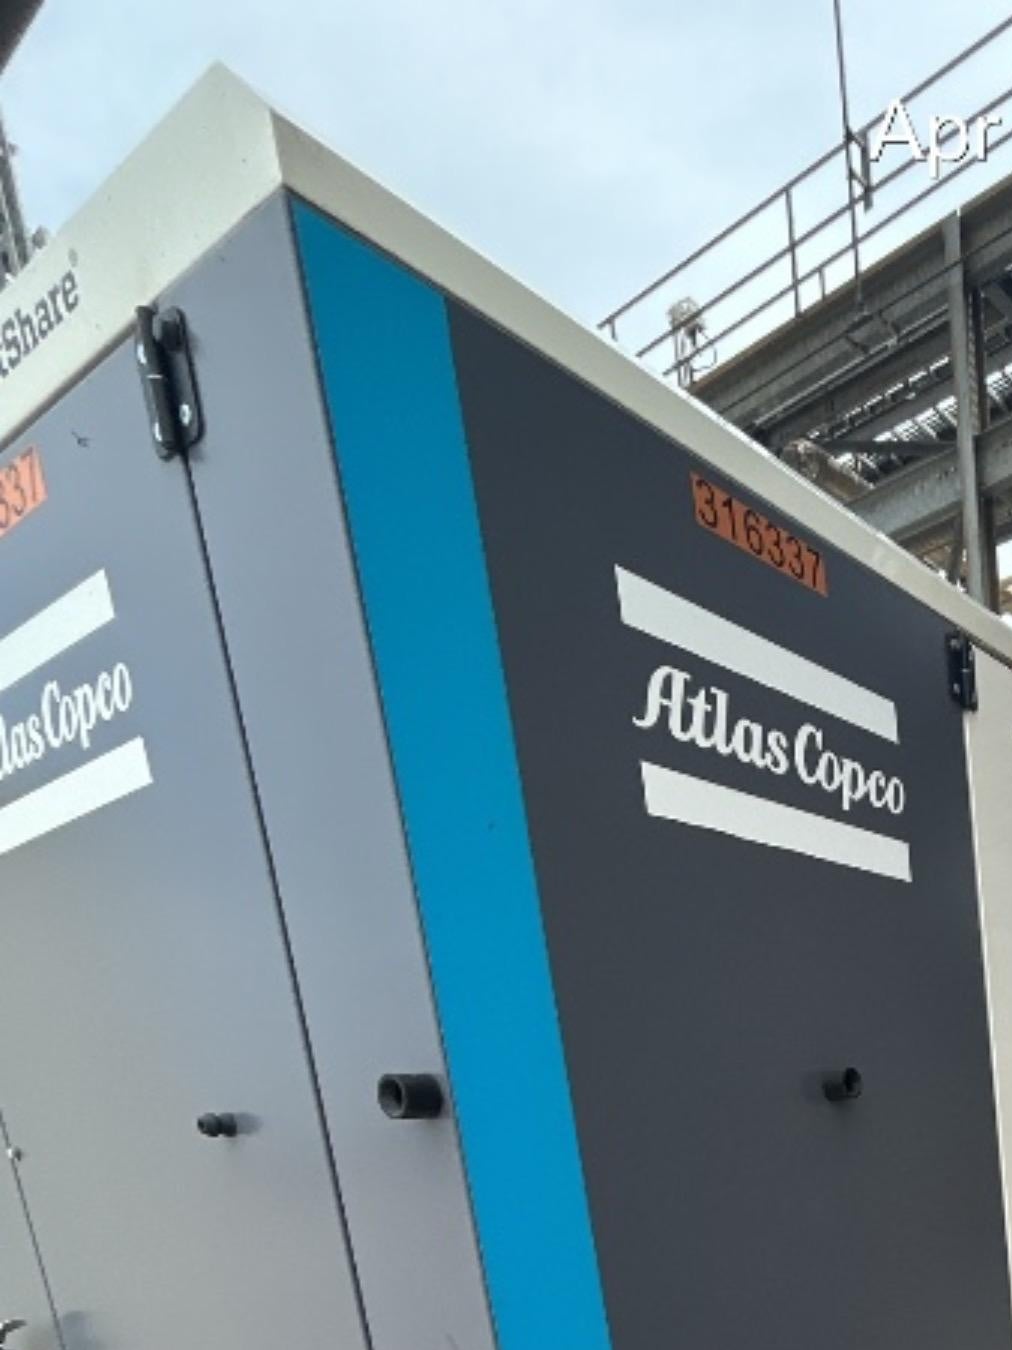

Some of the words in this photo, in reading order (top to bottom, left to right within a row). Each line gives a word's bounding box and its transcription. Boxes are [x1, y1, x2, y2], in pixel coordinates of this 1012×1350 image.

[696, 478, 819, 588] 316337
[0, 713, 45, 780] las
[41, 662, 133, 750] Copco
[632, 664, 789, 776] Atlas
[794, 722, 905, 814] Copco
